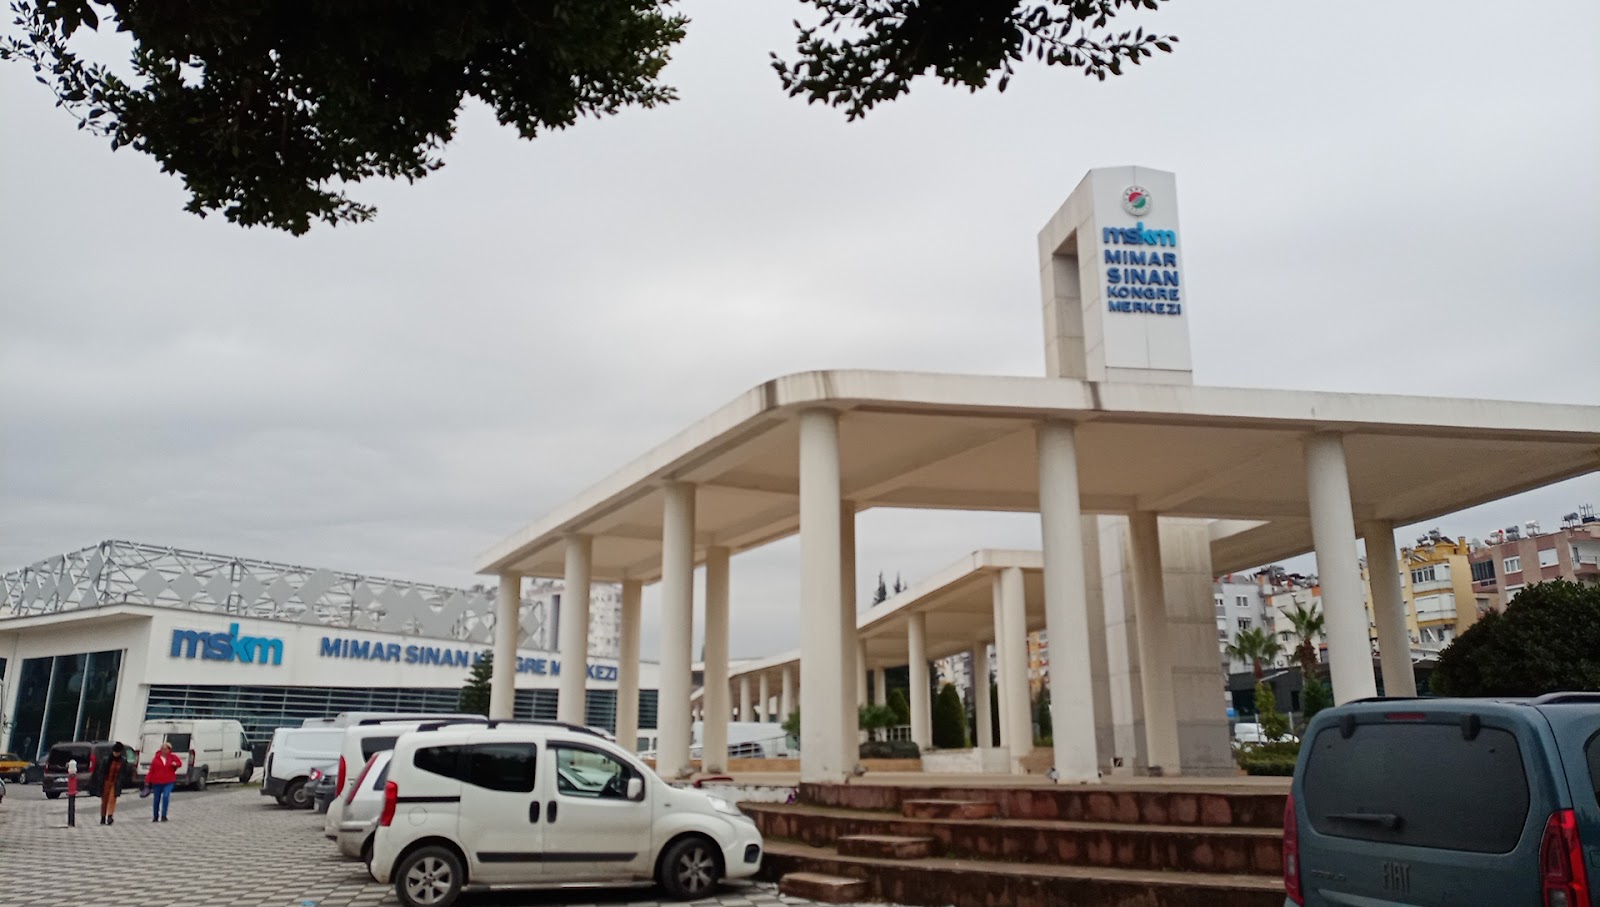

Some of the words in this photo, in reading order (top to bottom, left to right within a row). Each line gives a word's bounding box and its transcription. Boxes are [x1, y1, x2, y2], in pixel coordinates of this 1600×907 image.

[1103, 220, 1176, 247] mskm
[1107, 285, 1180, 301] KONGRE
[170, 623, 284, 666] mskm
